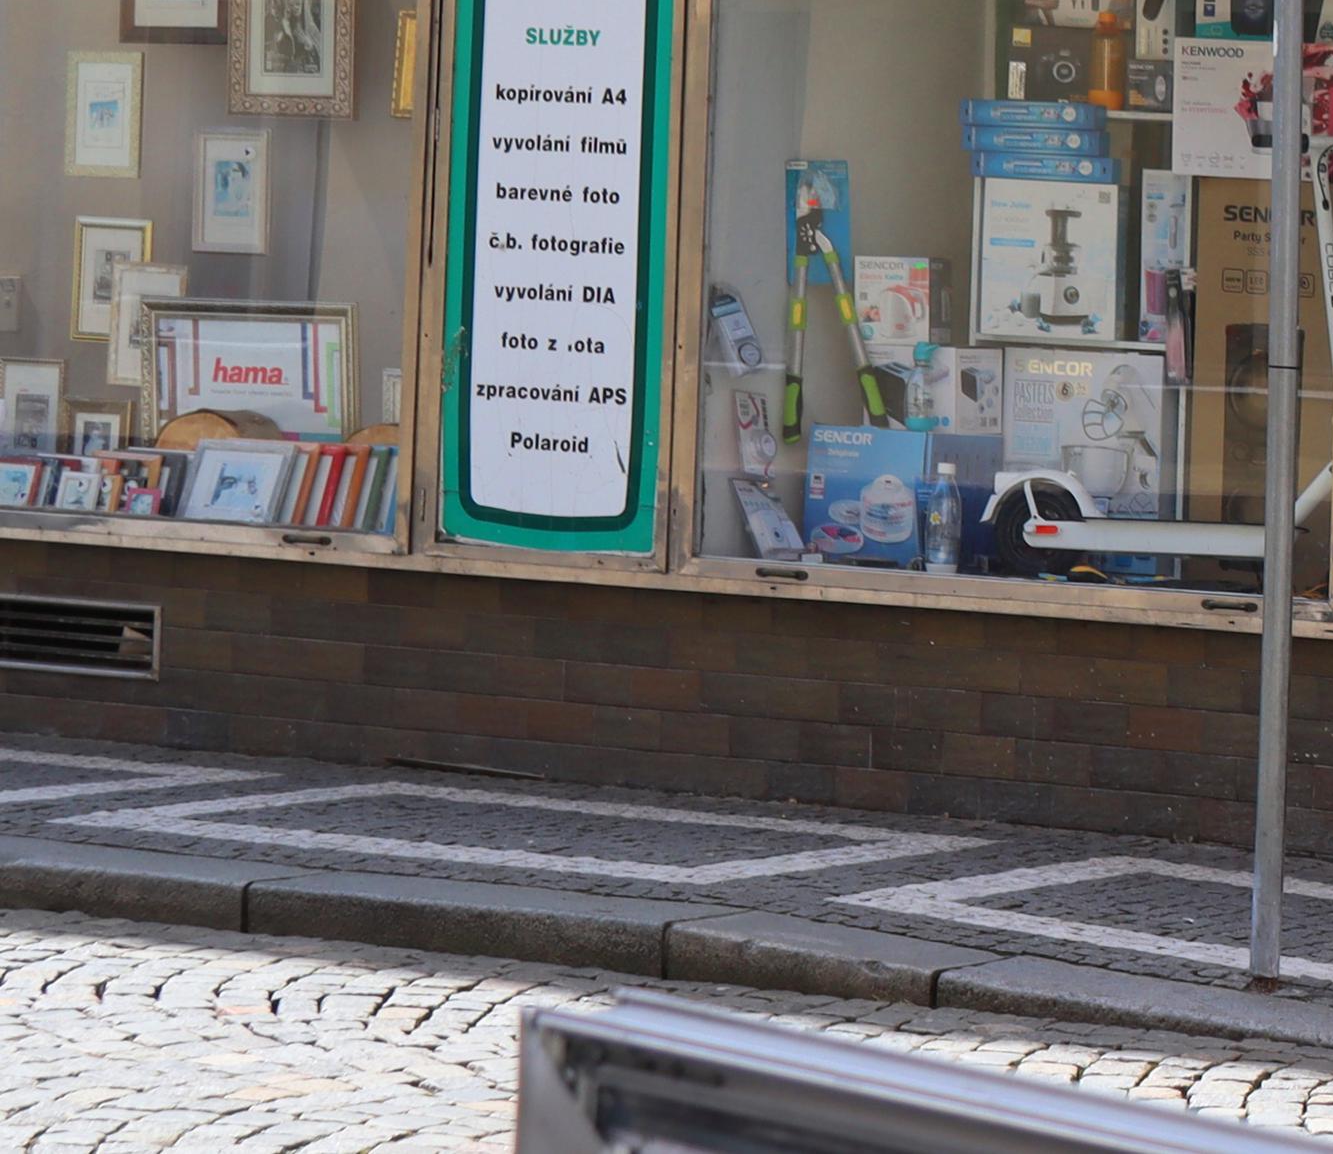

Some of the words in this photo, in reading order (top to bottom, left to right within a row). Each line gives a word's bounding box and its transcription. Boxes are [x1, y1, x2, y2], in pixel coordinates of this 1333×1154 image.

[525, 25, 601, 46] SLUŽBY
[1181, 46, 1245, 59] KENWOOD
[496, 84, 592, 104] kopírování
[602, 88, 627, 105] A4
[493, 135, 570, 153] vyvolání
[496, 183, 573, 202] barevné
[583, 187, 620, 205] foto
[1224, 205, 1315, 226] SENR
[531, 234, 625, 257] fotografie
[1234, 231, 1261, 243] Party
[859, 260, 905, 270] SENCOR
[494, 284, 573, 302] vyvolání
[582, 286, 616, 304] DIA
[501, 332, 539, 350] foto
[547, 339, 557, 351] z
[568, 338, 605, 353] ota
[212, 357, 284, 385] hama
[1014, 358, 1093, 377] SENCOR
[476, 384, 580, 402] zpracování
[588, 387, 627, 405] APS
[509, 432, 589, 454] Polaroid
[814, 429, 873, 446] SENCOR
